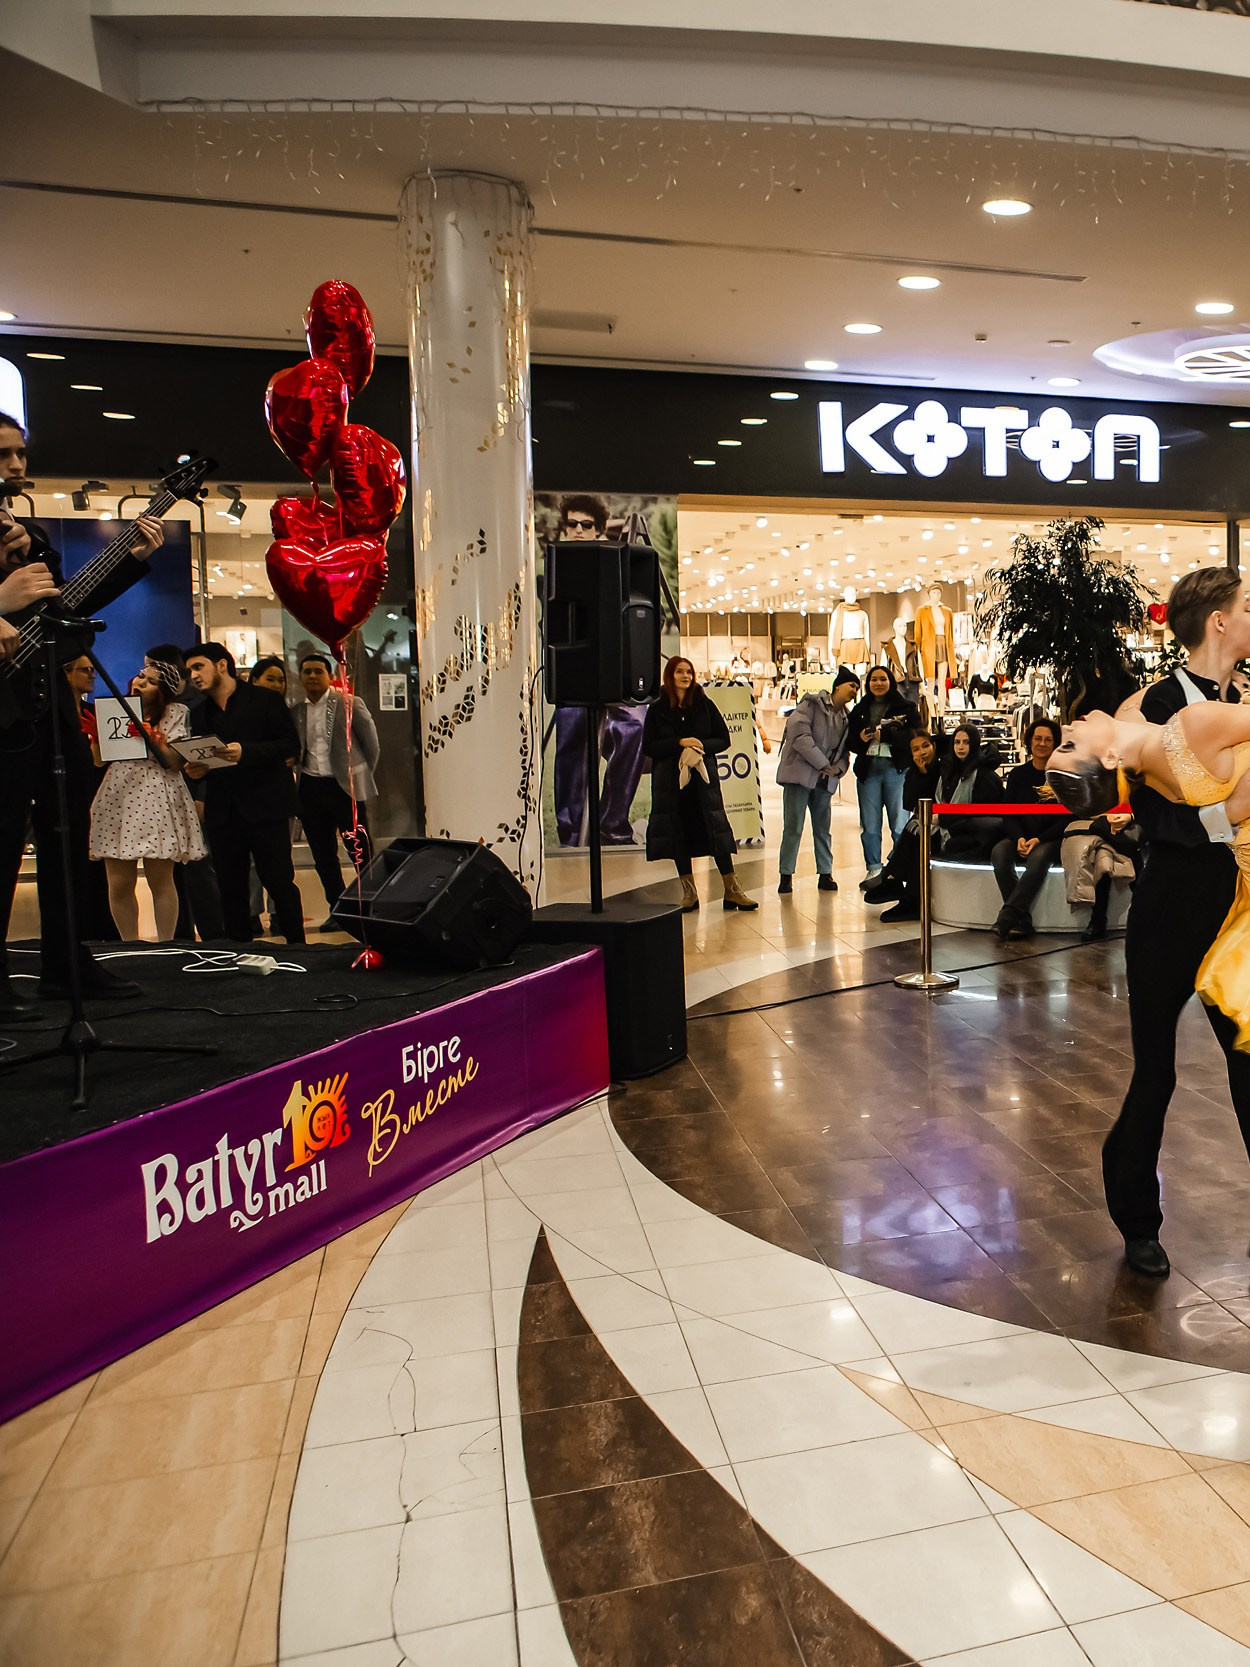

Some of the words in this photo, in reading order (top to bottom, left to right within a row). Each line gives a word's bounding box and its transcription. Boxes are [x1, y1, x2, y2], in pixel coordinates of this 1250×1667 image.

[722, 712, 749, 722] ЛДІКТЕР
[728, 724, 743, 734] ДКИ
[401, 1032, 463, 1084] Бірге
[361, 1056, 480, 1177] Вместе
[140, 1126, 285, 1244] Batyr
[265, 1160, 328, 1217] mall
